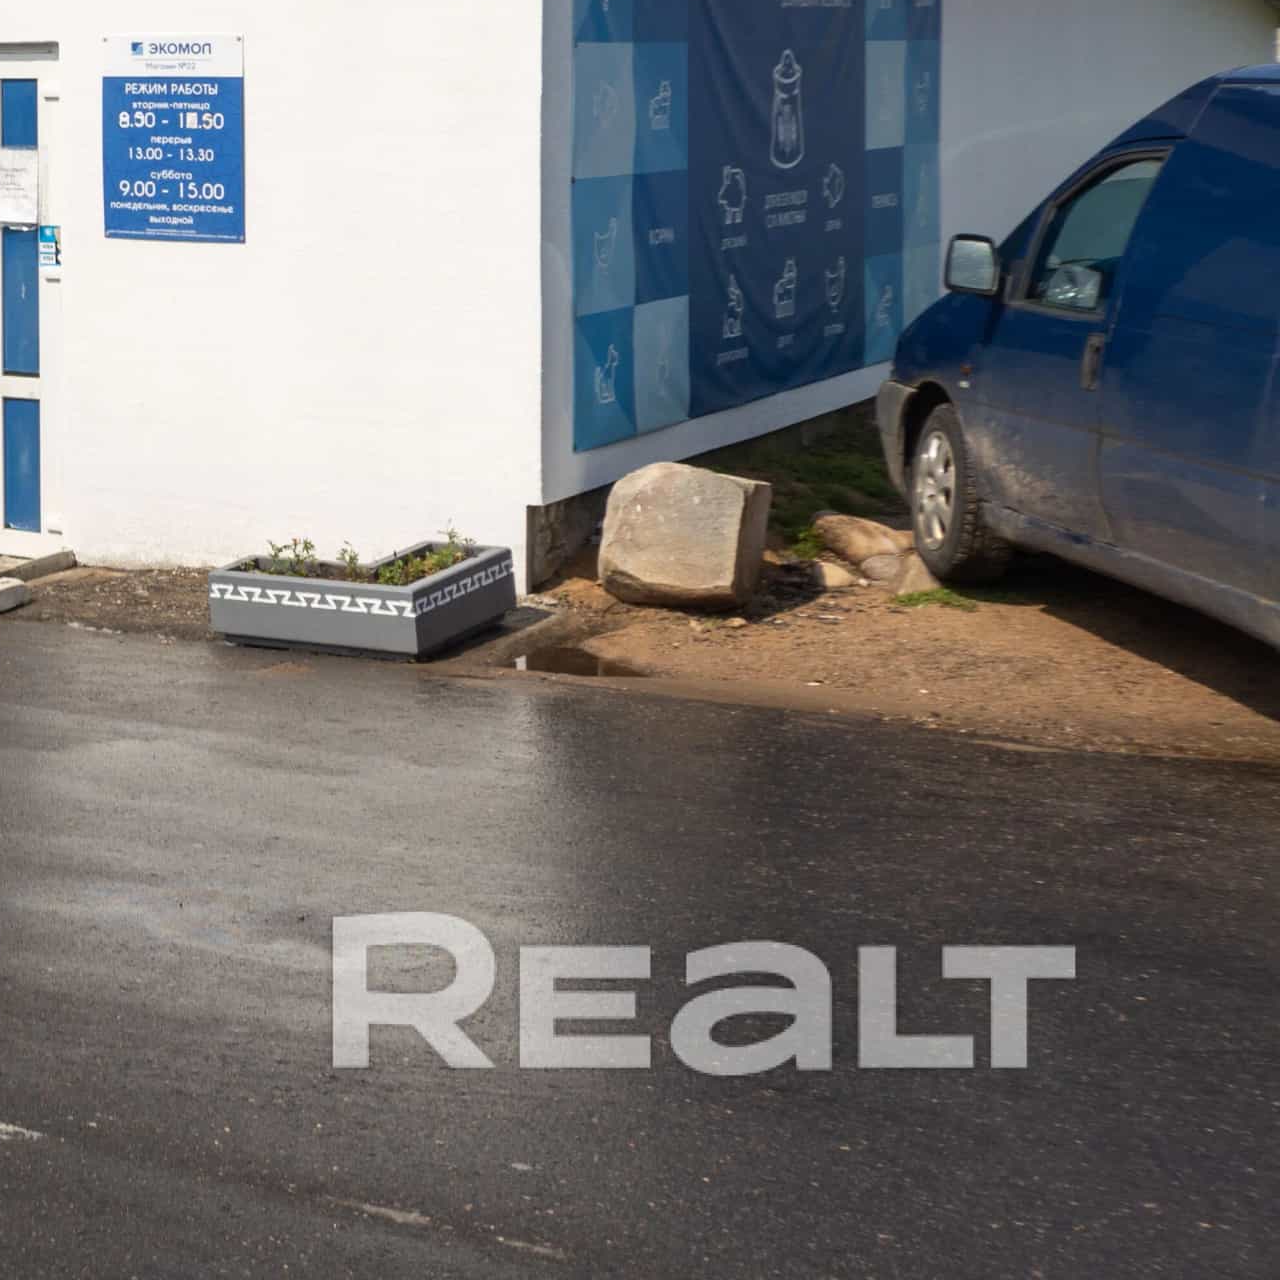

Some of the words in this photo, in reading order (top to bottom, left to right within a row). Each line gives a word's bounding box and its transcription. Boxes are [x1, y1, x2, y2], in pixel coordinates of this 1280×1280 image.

[124, 83, 168, 95] РЕЖИМ
[171, 83, 219, 96] РАБОТЫ
[128, 147, 163, 160] 13.00
[179, 148, 215, 162] 13.30
[150, 170, 193, 181] суббота
[119, 180, 156, 198] 9.00
[179, 182, 225, 200] 15.00
